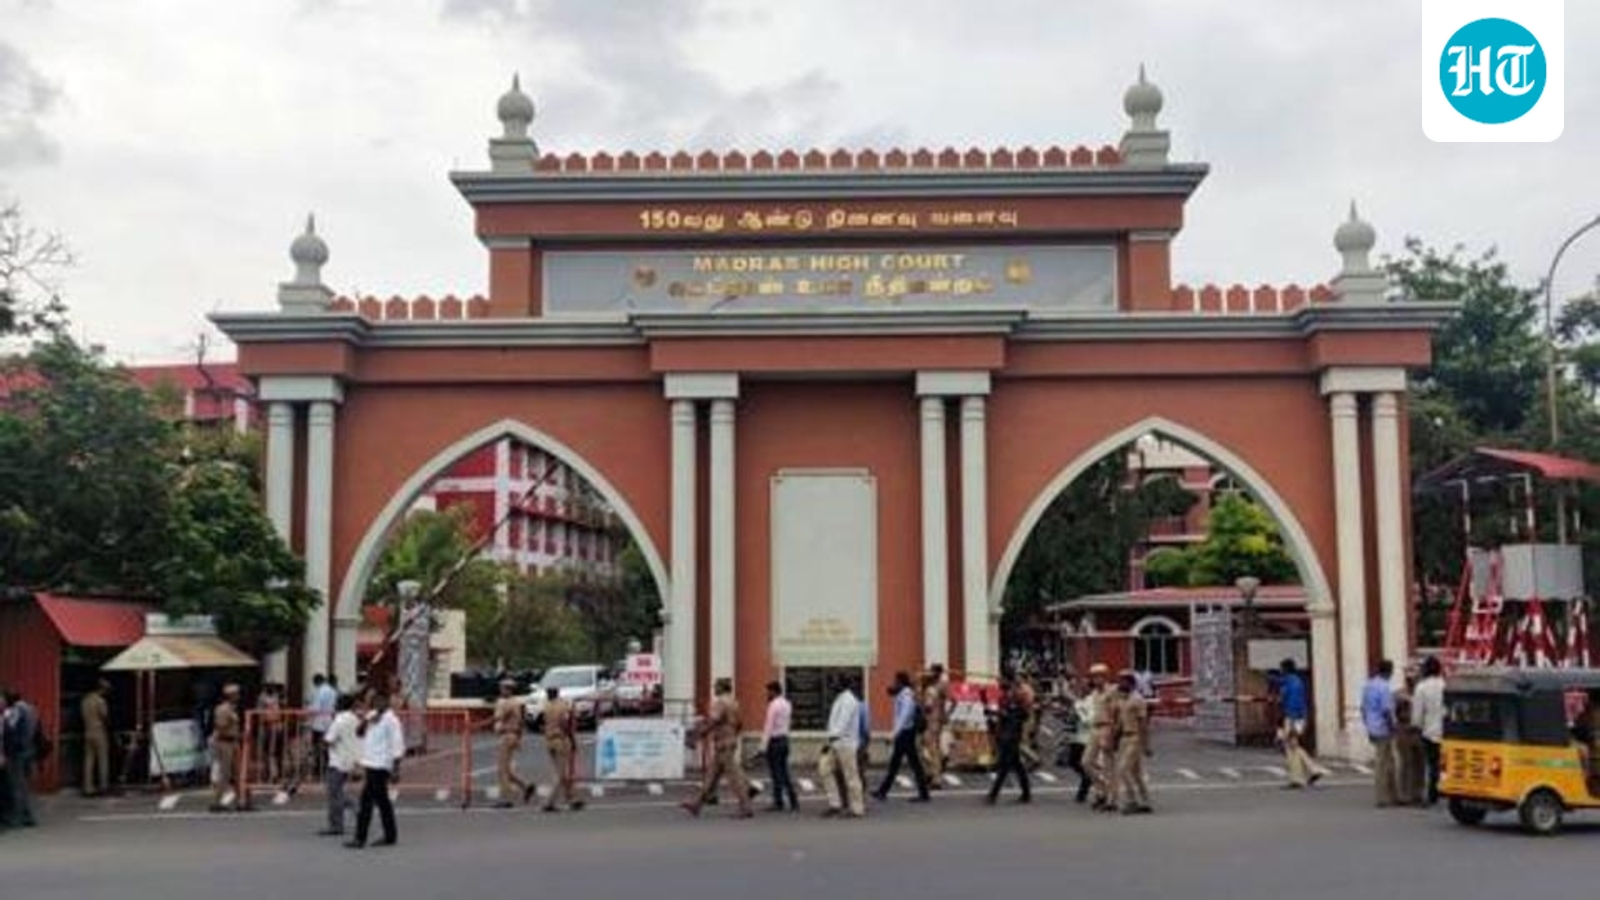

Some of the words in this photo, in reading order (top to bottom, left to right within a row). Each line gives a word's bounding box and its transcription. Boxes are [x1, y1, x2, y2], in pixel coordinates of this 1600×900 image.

[692, 256, 799, 272] MADRAS
[810, 255, 870, 270] HIGH
[880, 254, 965, 270] COURT
